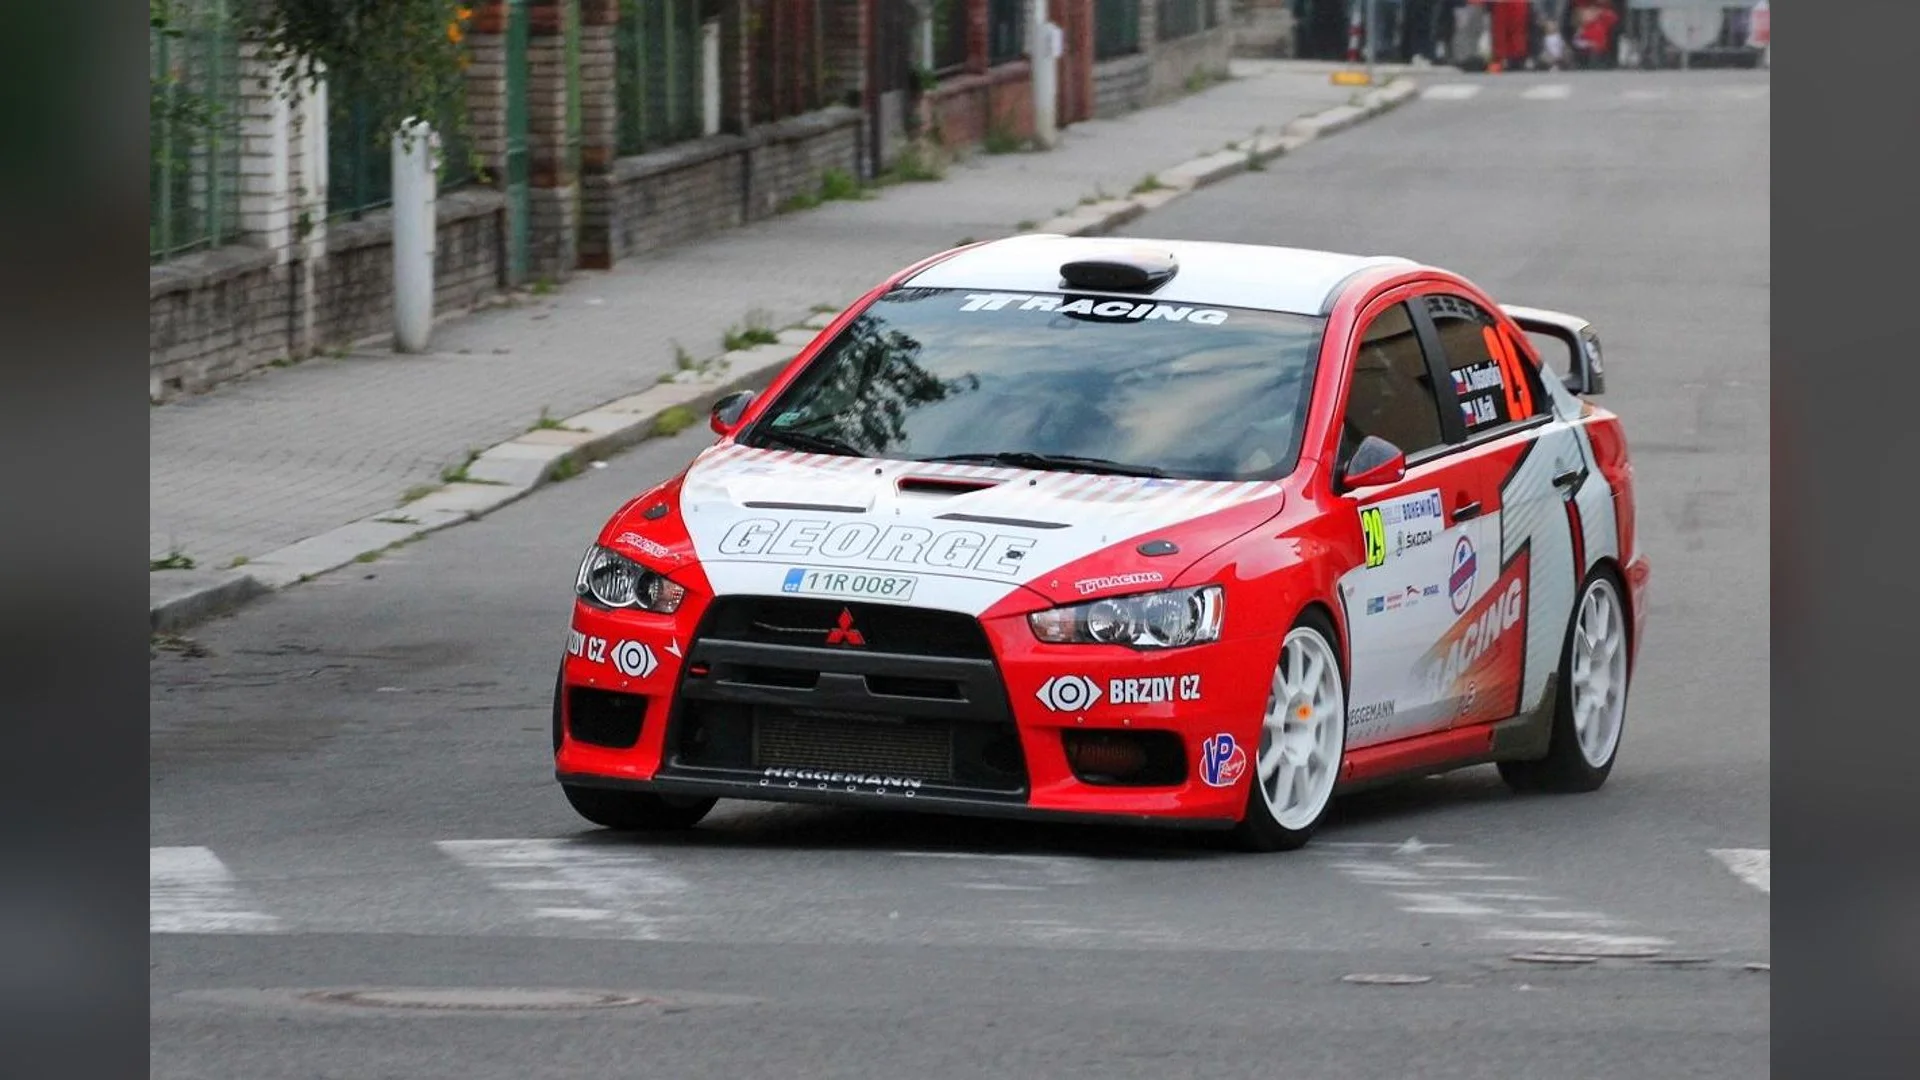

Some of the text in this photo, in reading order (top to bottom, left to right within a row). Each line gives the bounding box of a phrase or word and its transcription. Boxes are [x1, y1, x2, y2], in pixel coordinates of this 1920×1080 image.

[718, 518, 1037, 576] GEORGE
[1362, 508, 1386, 568] 29
[807, 572, 848, 591] 11R
[854, 575, 913, 596] 0087
[588, 636, 606, 663] CZ
[1110, 674, 1201, 704] BRZDY CZ
[1203, 733, 1235, 786] VP
